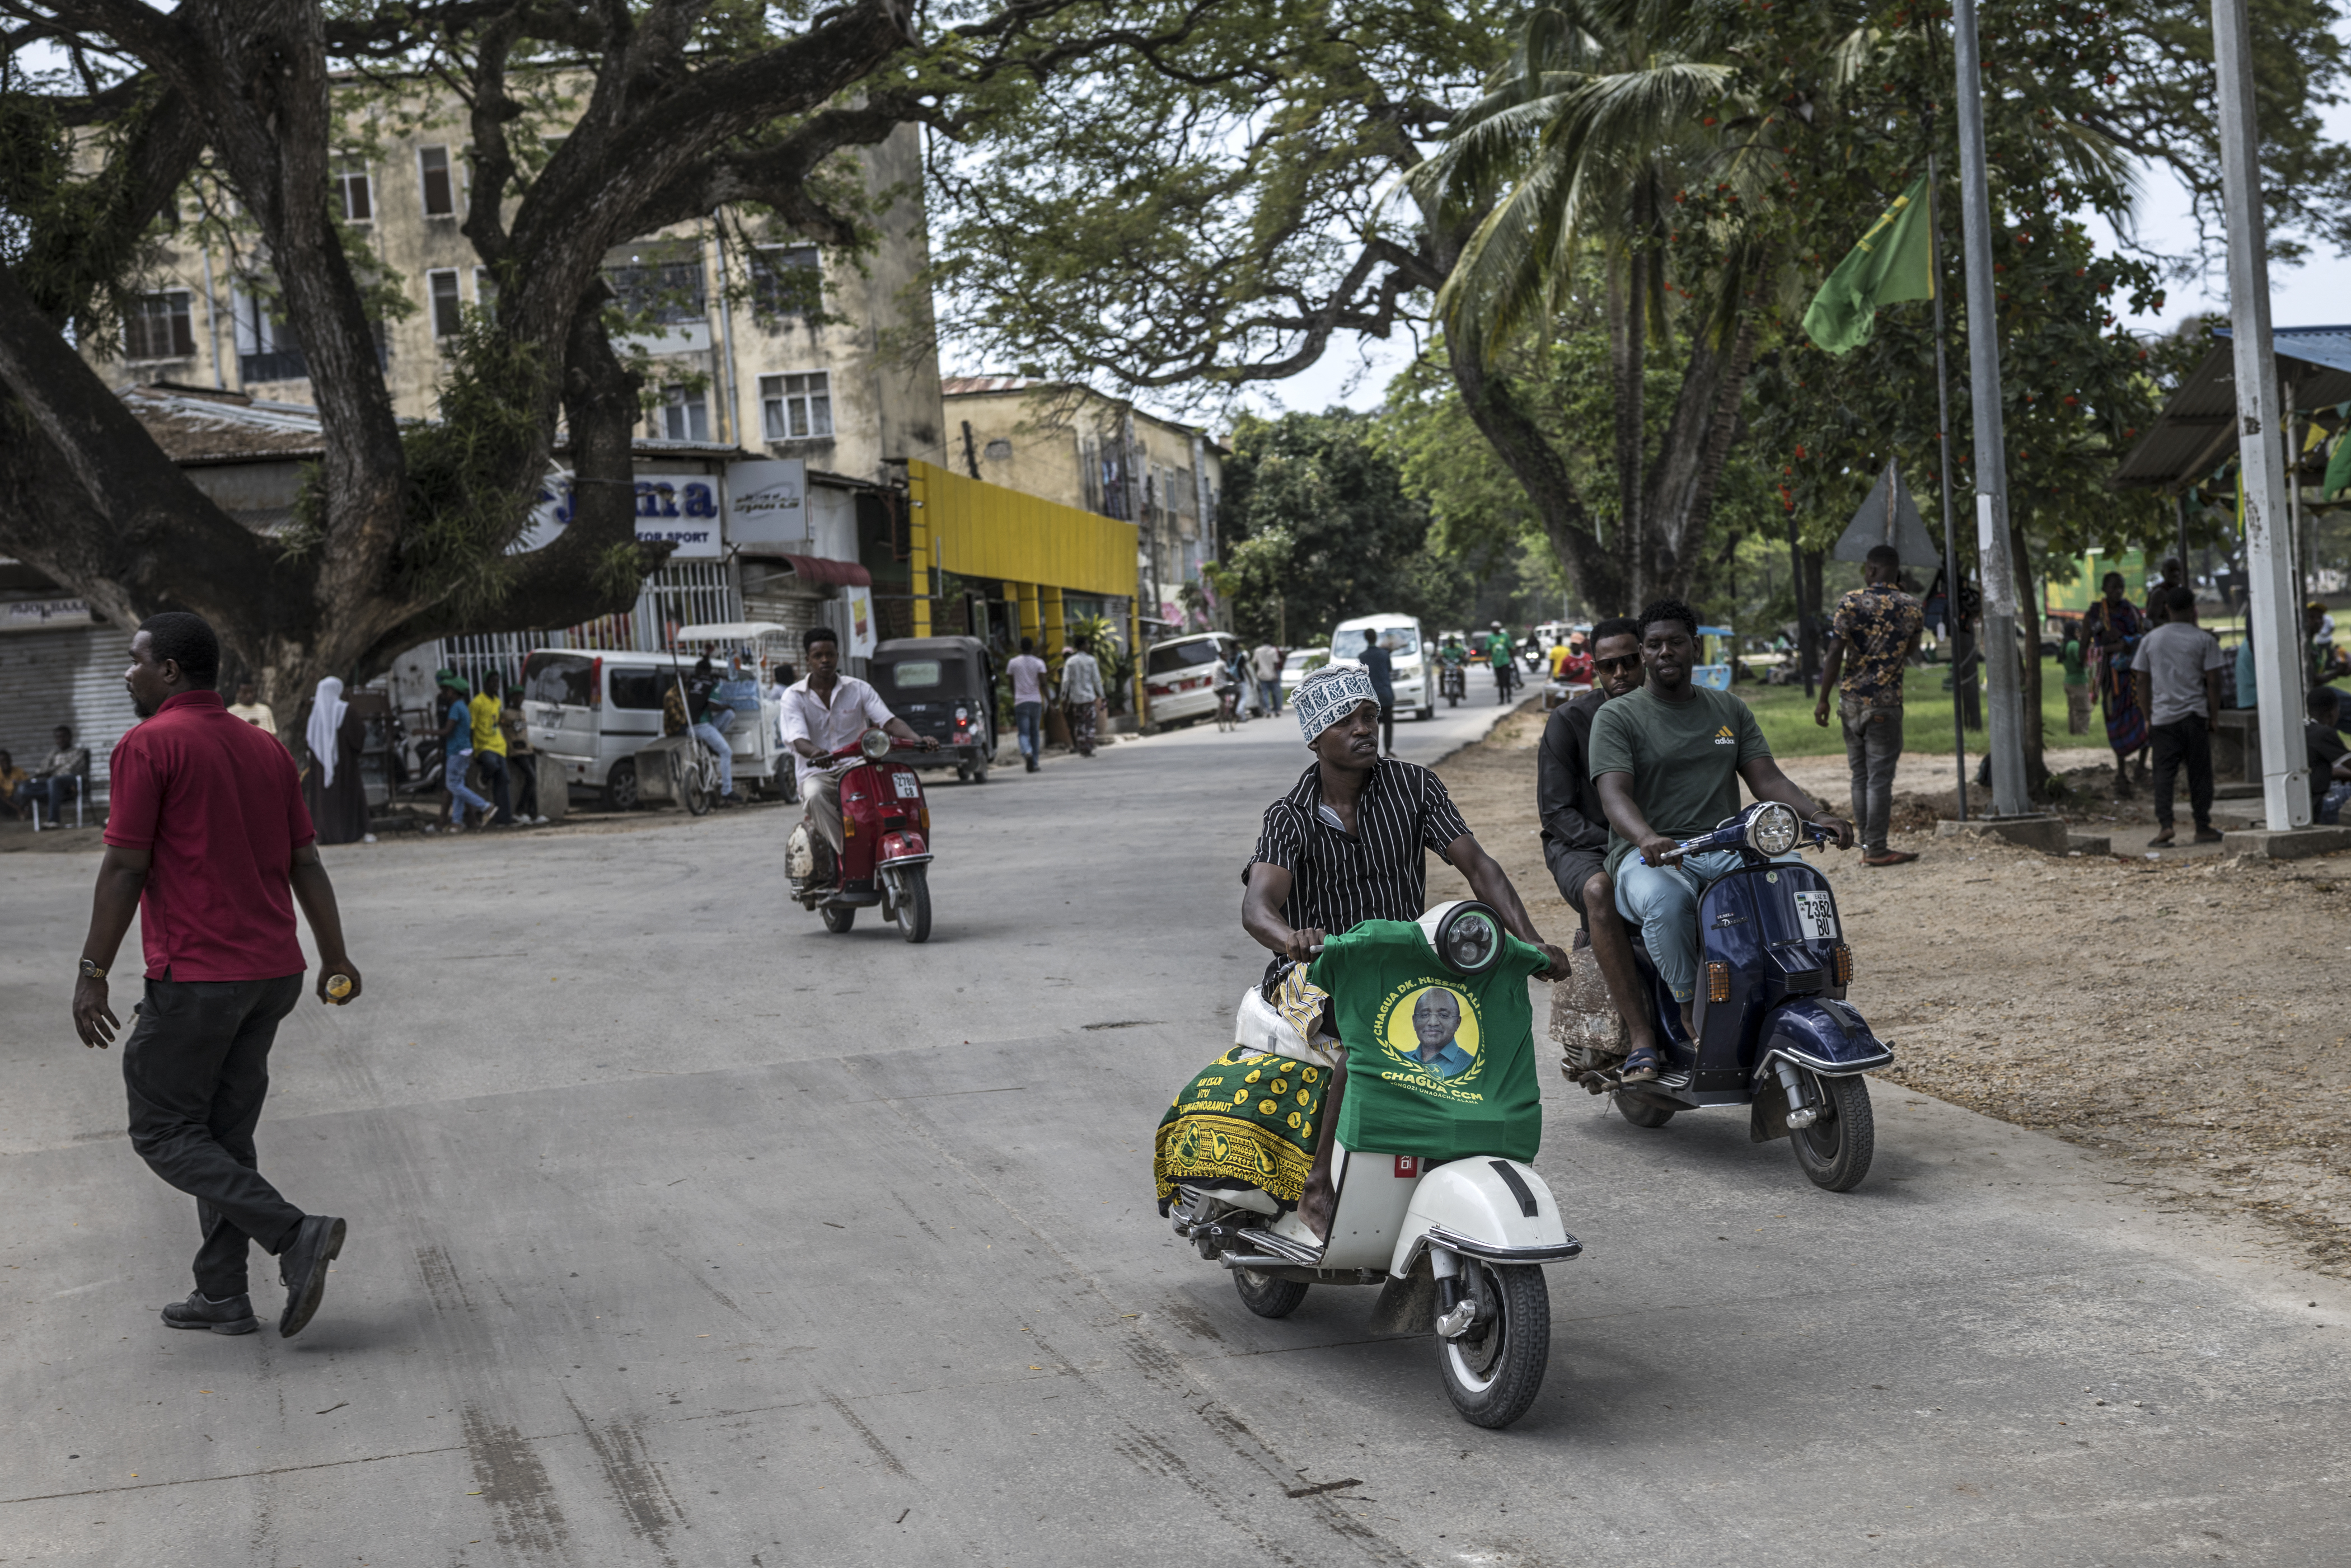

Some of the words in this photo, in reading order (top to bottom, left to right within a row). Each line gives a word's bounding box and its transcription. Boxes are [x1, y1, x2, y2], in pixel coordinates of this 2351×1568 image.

[666, 532, 709, 543] SPORT
[905, 787, 914, 797] CB
[1804, 900, 1832, 919] Z352
[1816, 918, 1830, 936] BU
[1373, 992, 1399, 1036] CHAGUA
[1397, 979, 1417, 994] DK.
[1417, 976, 1468, 993] HUSSEIN
[1466, 992, 1481, 1010] ALI
[1381, 1071, 1448, 1094] CHAGUA
[1451, 1090, 1484, 1101] CCM
[1419, 1088, 1455, 1101] UNAOACHA
